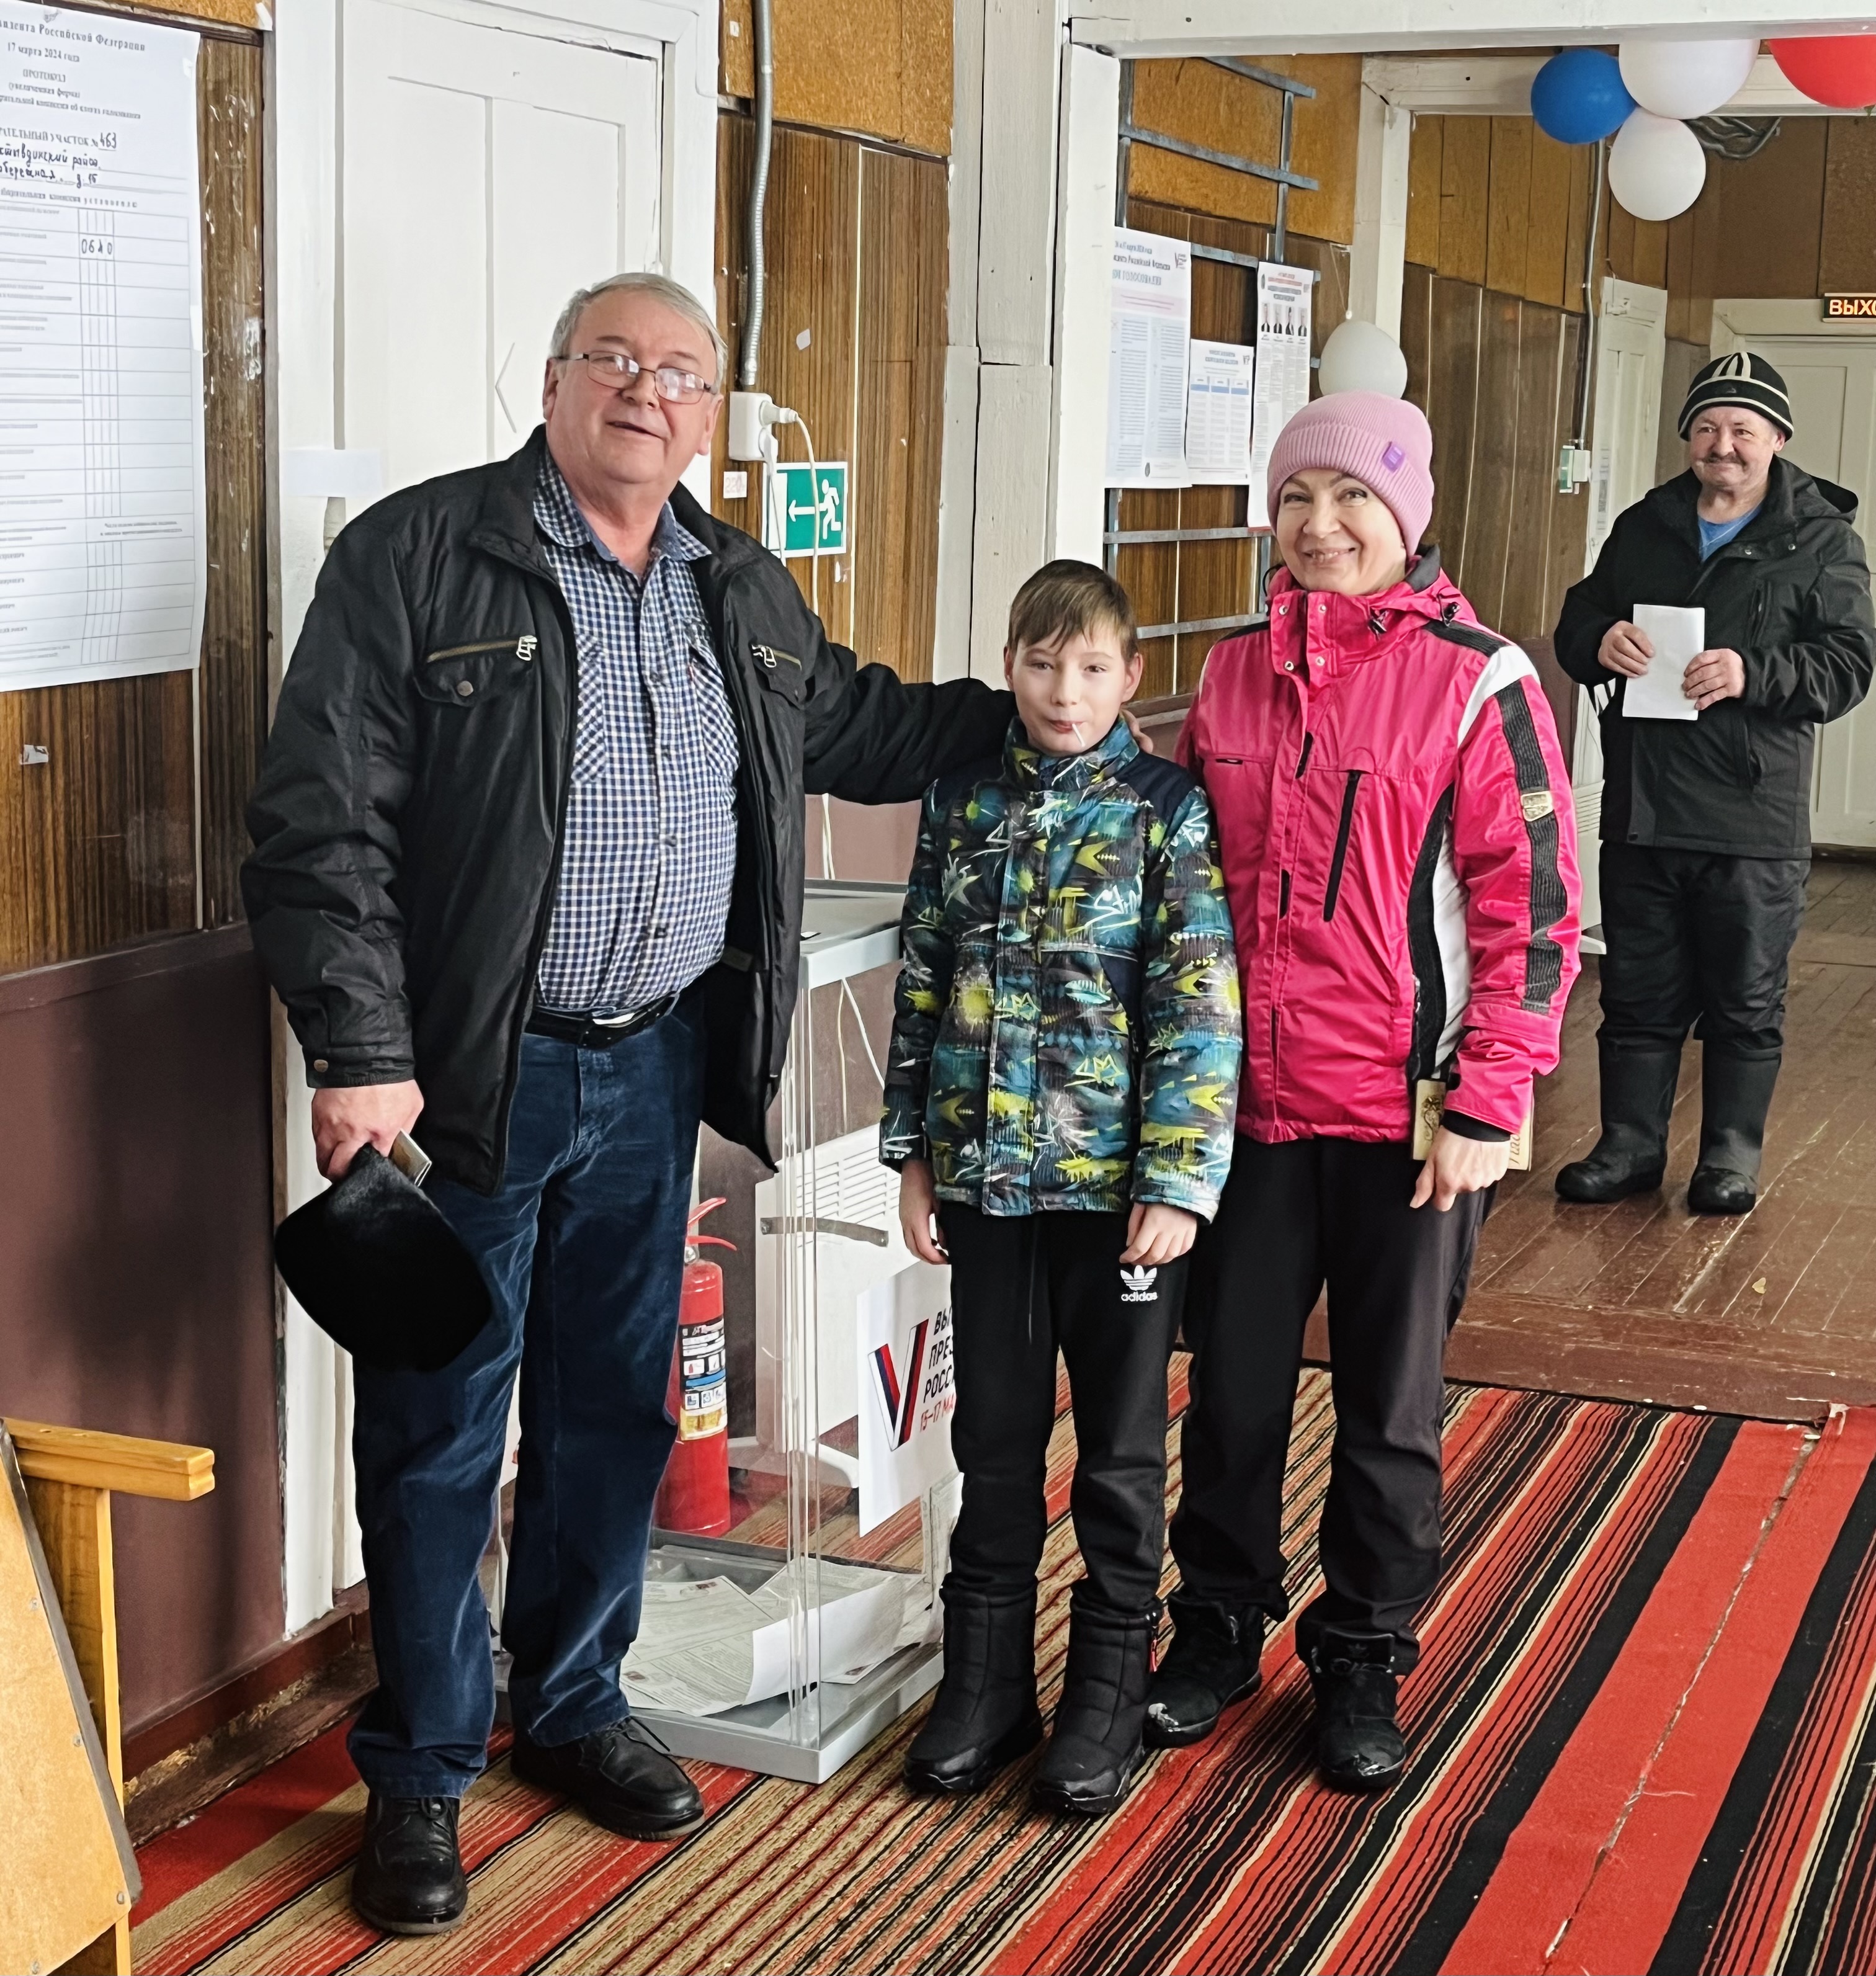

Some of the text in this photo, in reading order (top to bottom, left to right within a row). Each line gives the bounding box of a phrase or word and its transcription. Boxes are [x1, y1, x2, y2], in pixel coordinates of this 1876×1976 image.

[40, 24, 92, 42] Российской
[96, 34, 146, 51] Федерации
[45, 48, 62, 60] 2024
[100, 132, 117, 149] 463
[1120, 1291, 1158, 1302] adidas
